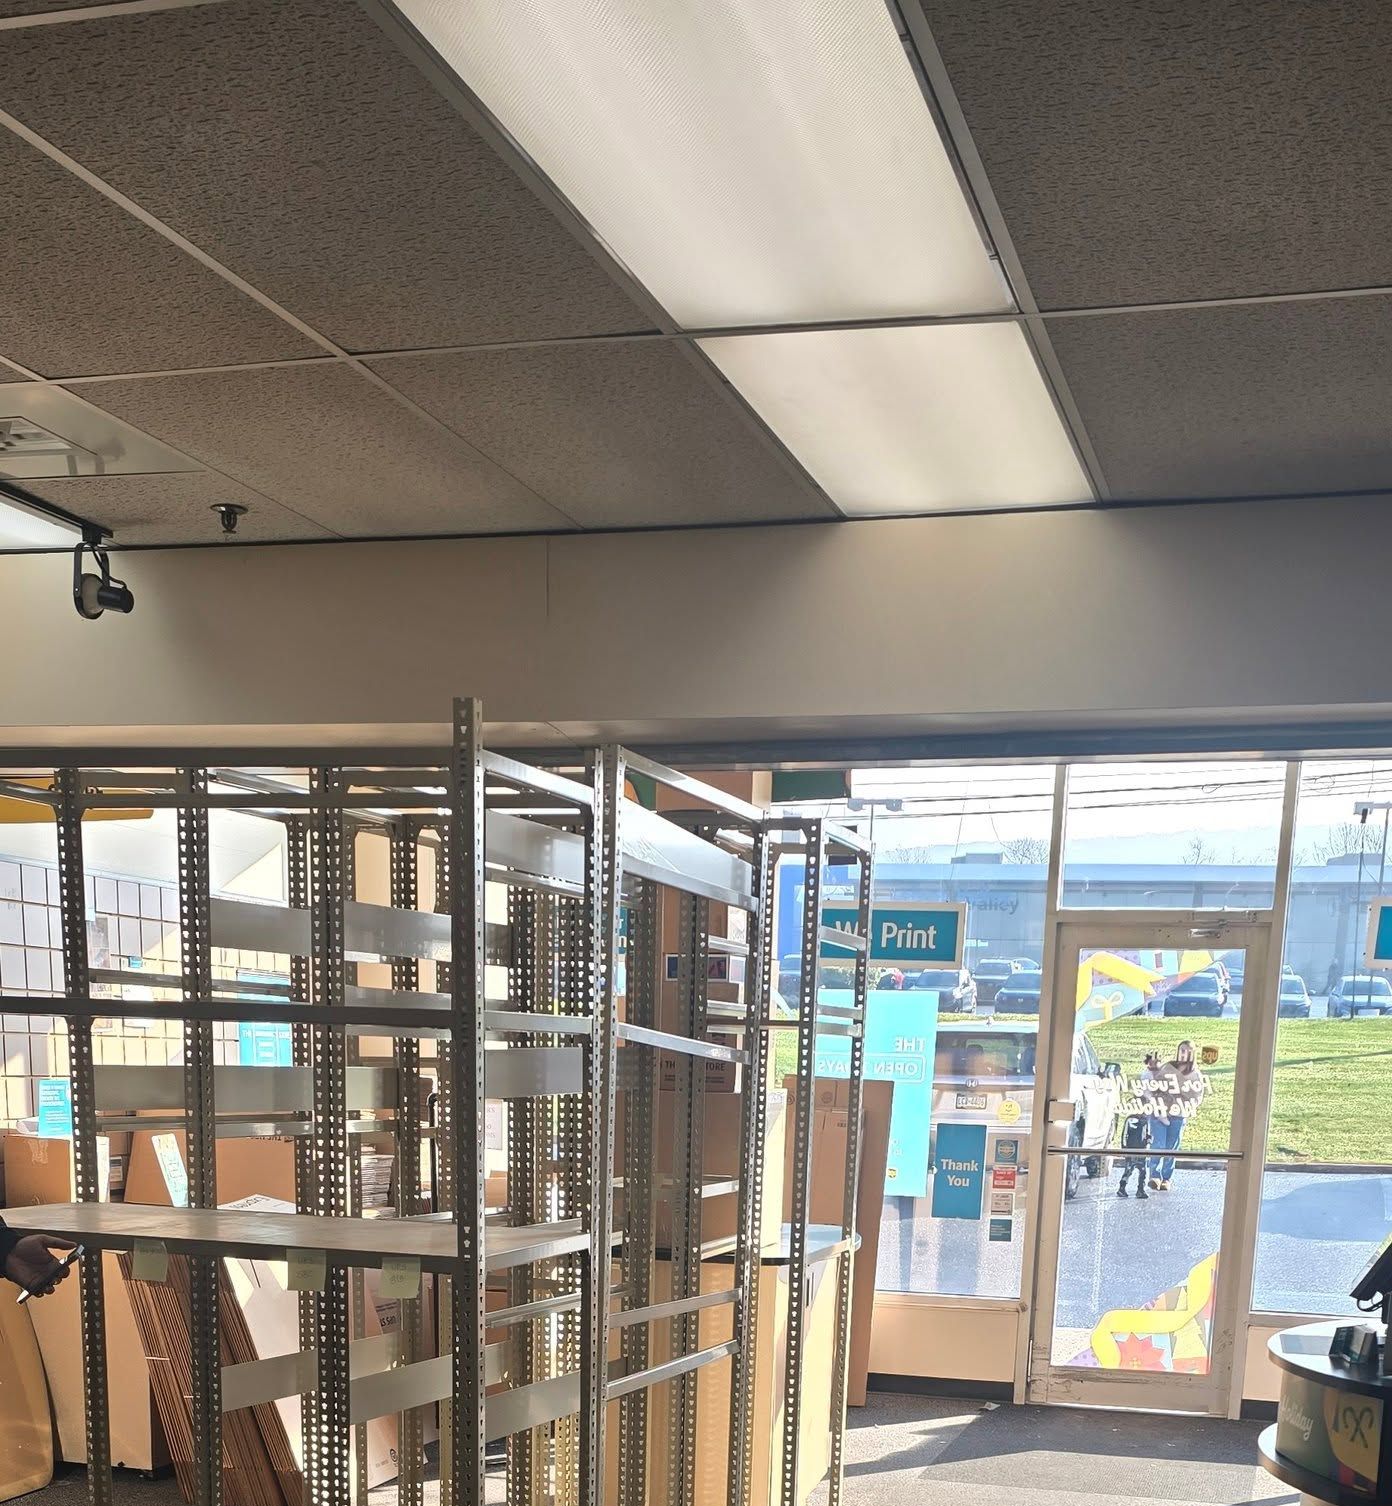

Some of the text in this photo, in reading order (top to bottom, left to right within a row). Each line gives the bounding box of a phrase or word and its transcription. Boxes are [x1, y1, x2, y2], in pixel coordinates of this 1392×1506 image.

[881, 921, 937, 949] Print
[705, 1062, 726, 1072] TORE
[941, 1158, 979, 1172] Thank
[946, 1175, 970, 1187] You
